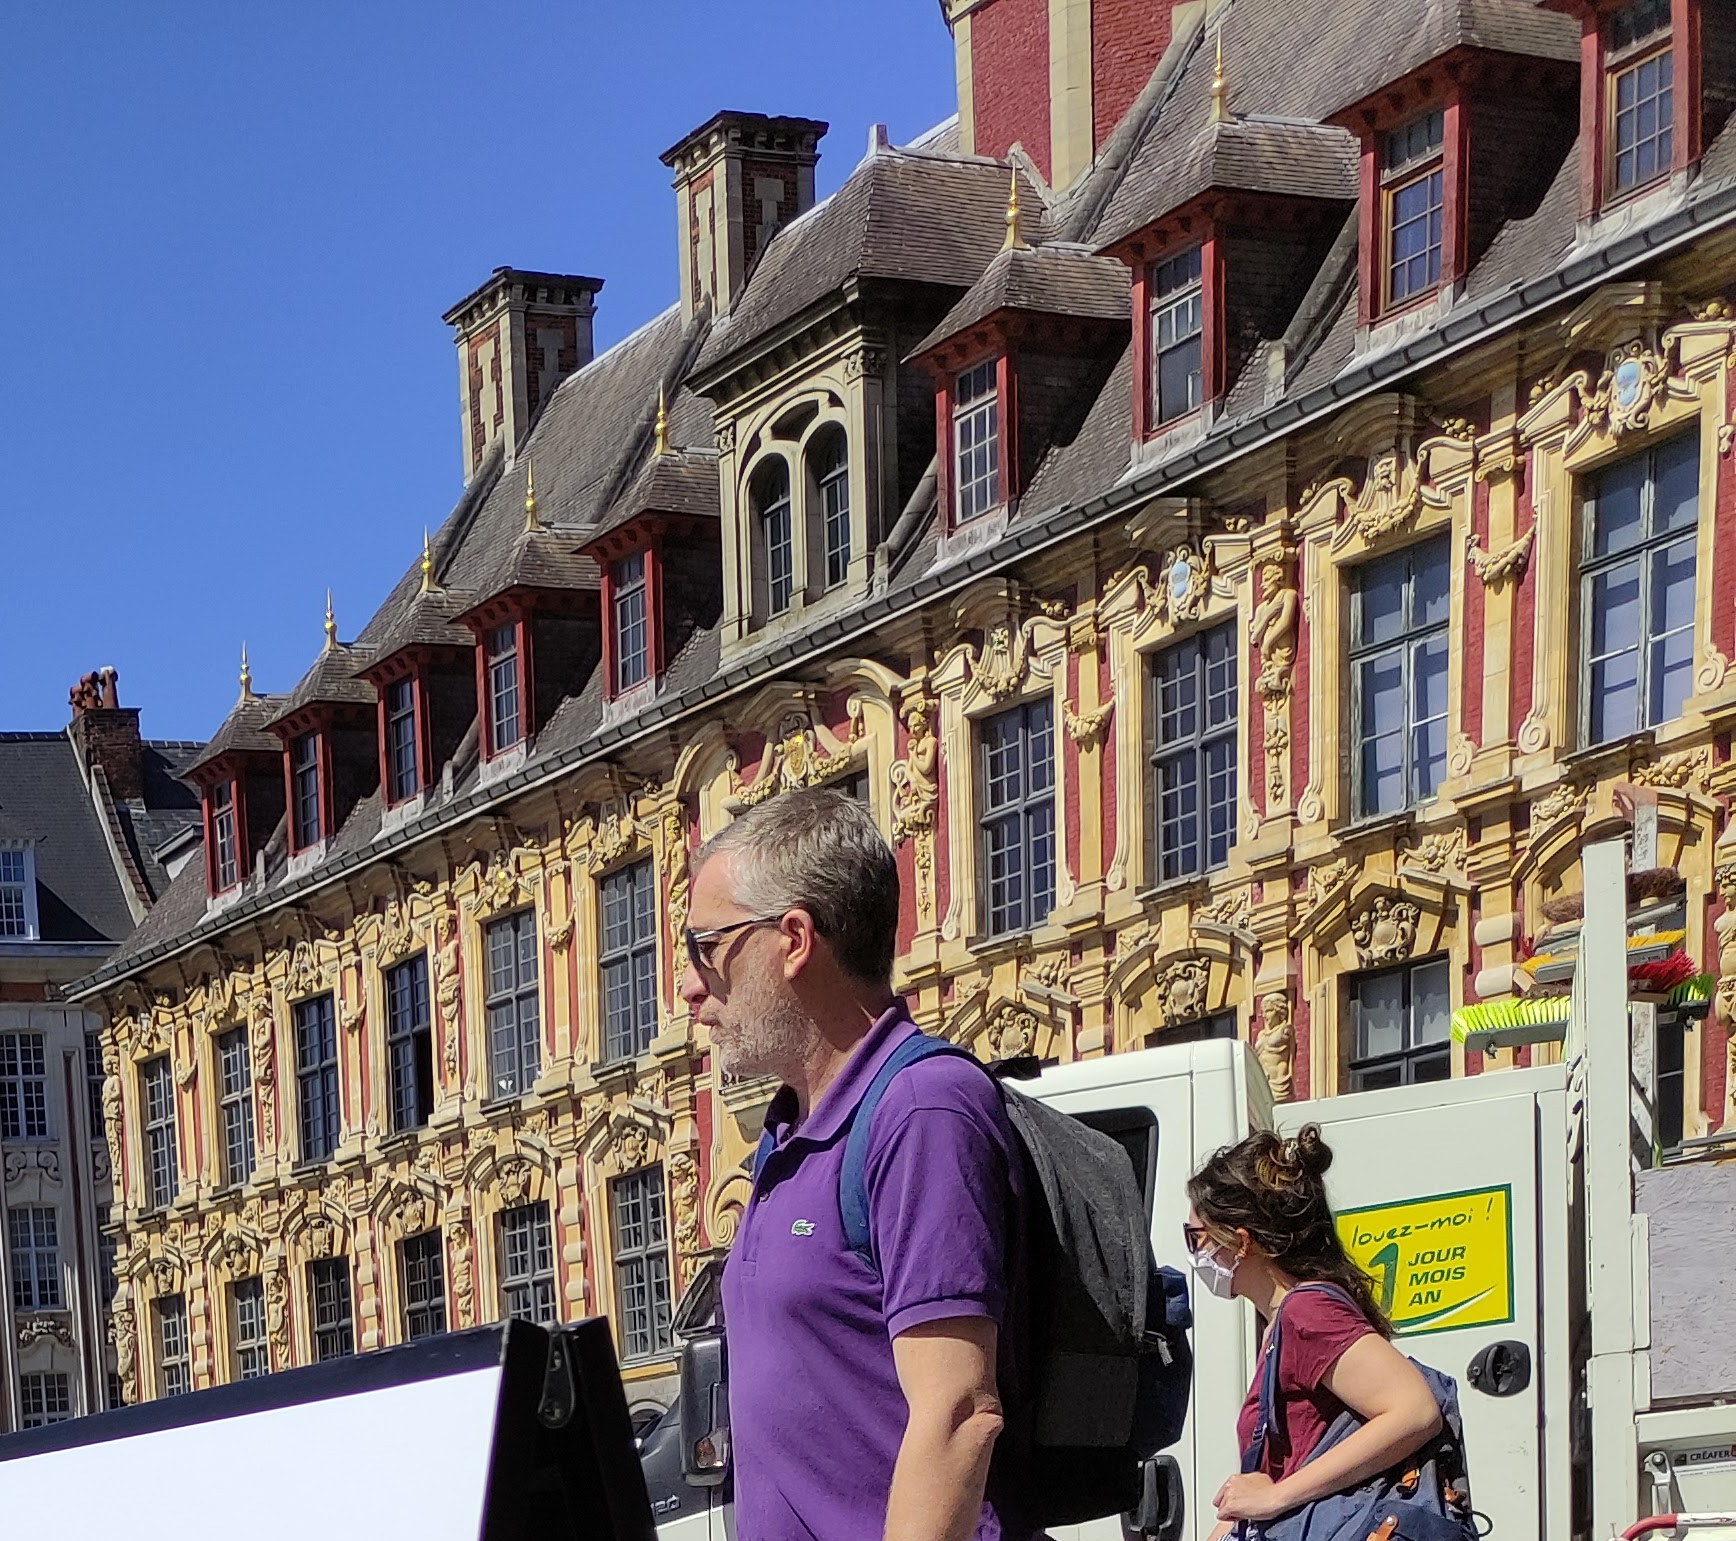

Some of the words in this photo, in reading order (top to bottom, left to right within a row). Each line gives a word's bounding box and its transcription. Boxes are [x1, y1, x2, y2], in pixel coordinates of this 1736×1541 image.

[1407, 1245, 1467, 1267] JOUR
[1367, 1242, 1400, 1319] 1
[1408, 1265, 1467, 1287] MOIS
[1407, 1289, 1442, 1307] AN
